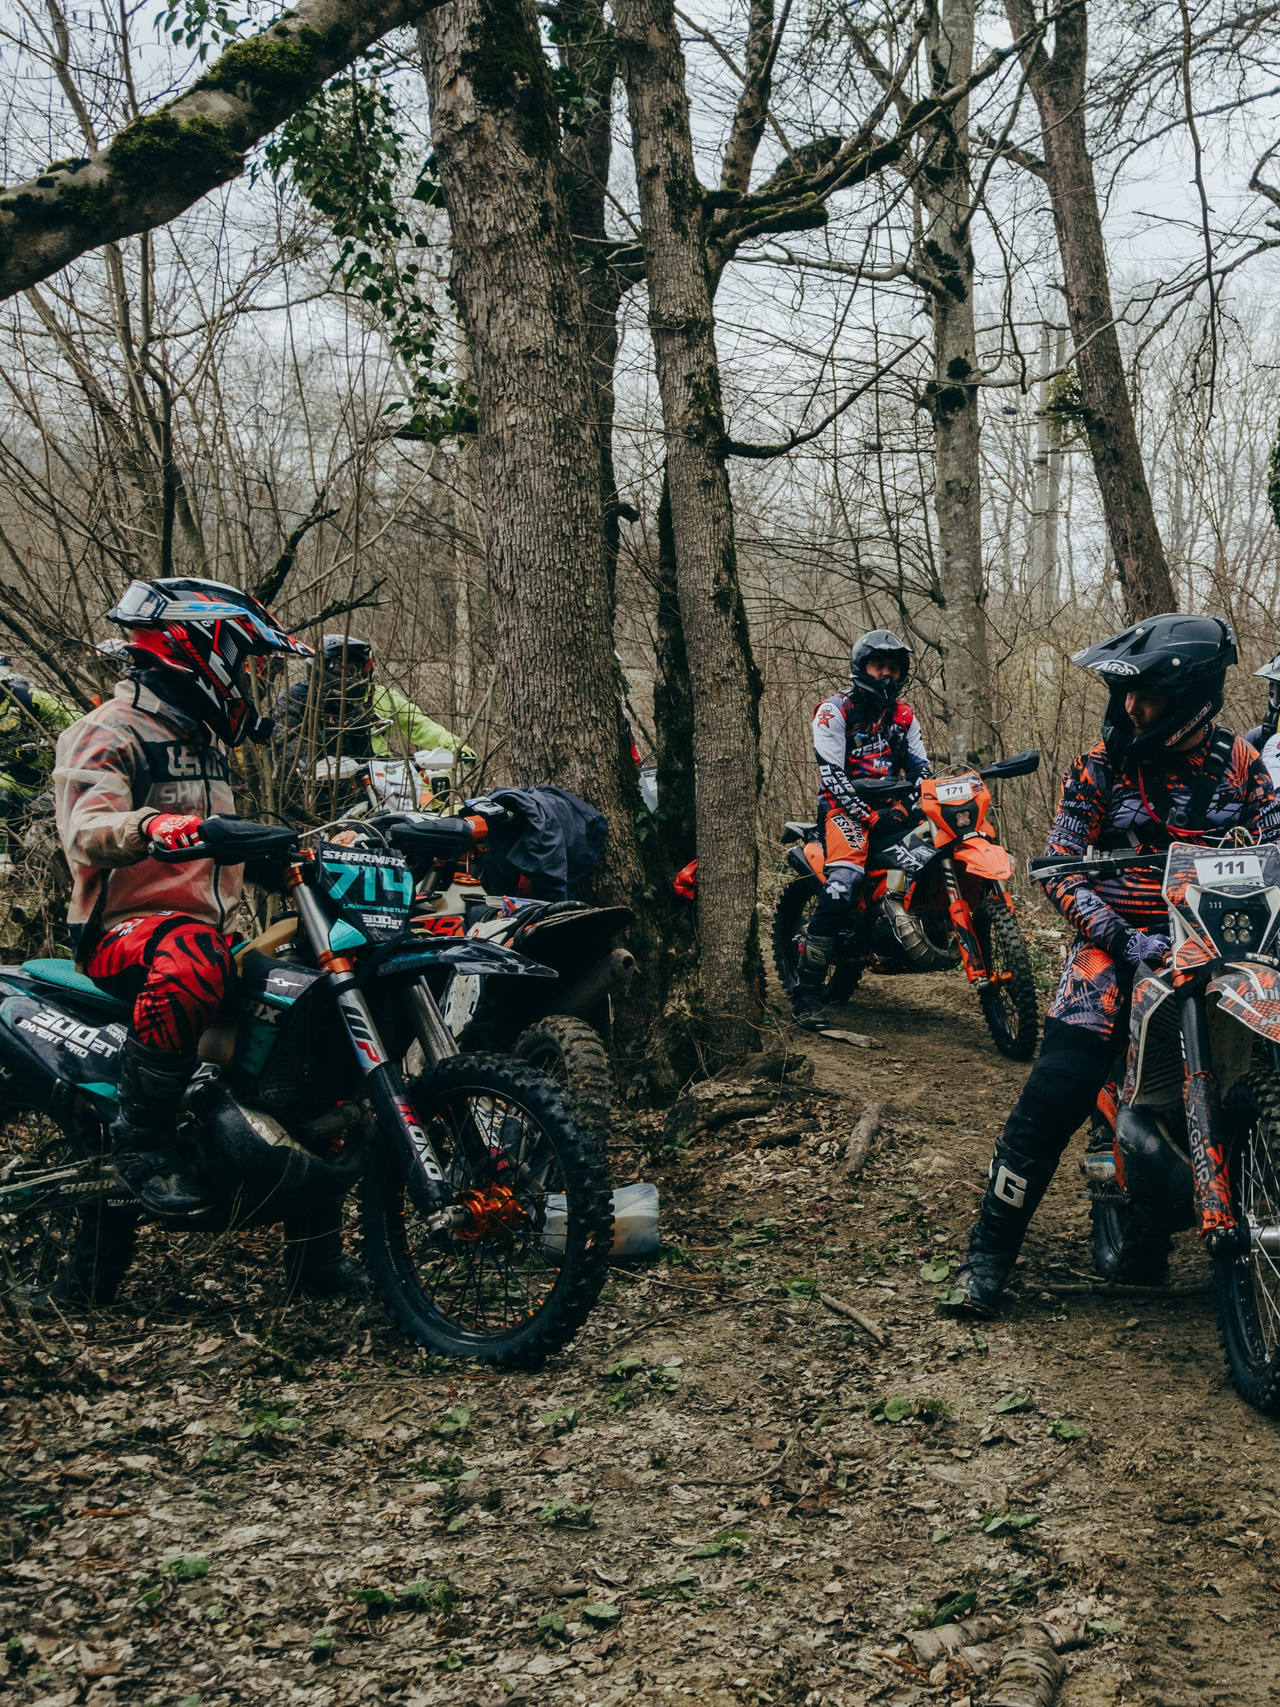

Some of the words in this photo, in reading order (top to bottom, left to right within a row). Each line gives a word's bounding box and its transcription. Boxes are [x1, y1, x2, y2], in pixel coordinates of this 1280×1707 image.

[1102, 662, 1134, 675] Airoh
[819, 764, 870, 818] DESANT
[945, 786, 963, 796] 171
[322, 850, 405, 868] SHARMAX
[1213, 861, 1245, 875] 111
[322, 862, 413, 906] 714
[362, 914, 392, 925] 300
[16, 1019, 64, 1044] EXPERT
[30, 1008, 101, 1048] 300
[89, 1038, 119, 1058] 2T
[1185, 1103, 1210, 1183] X-GRIP
[994, 1165, 1028, 1209] G
